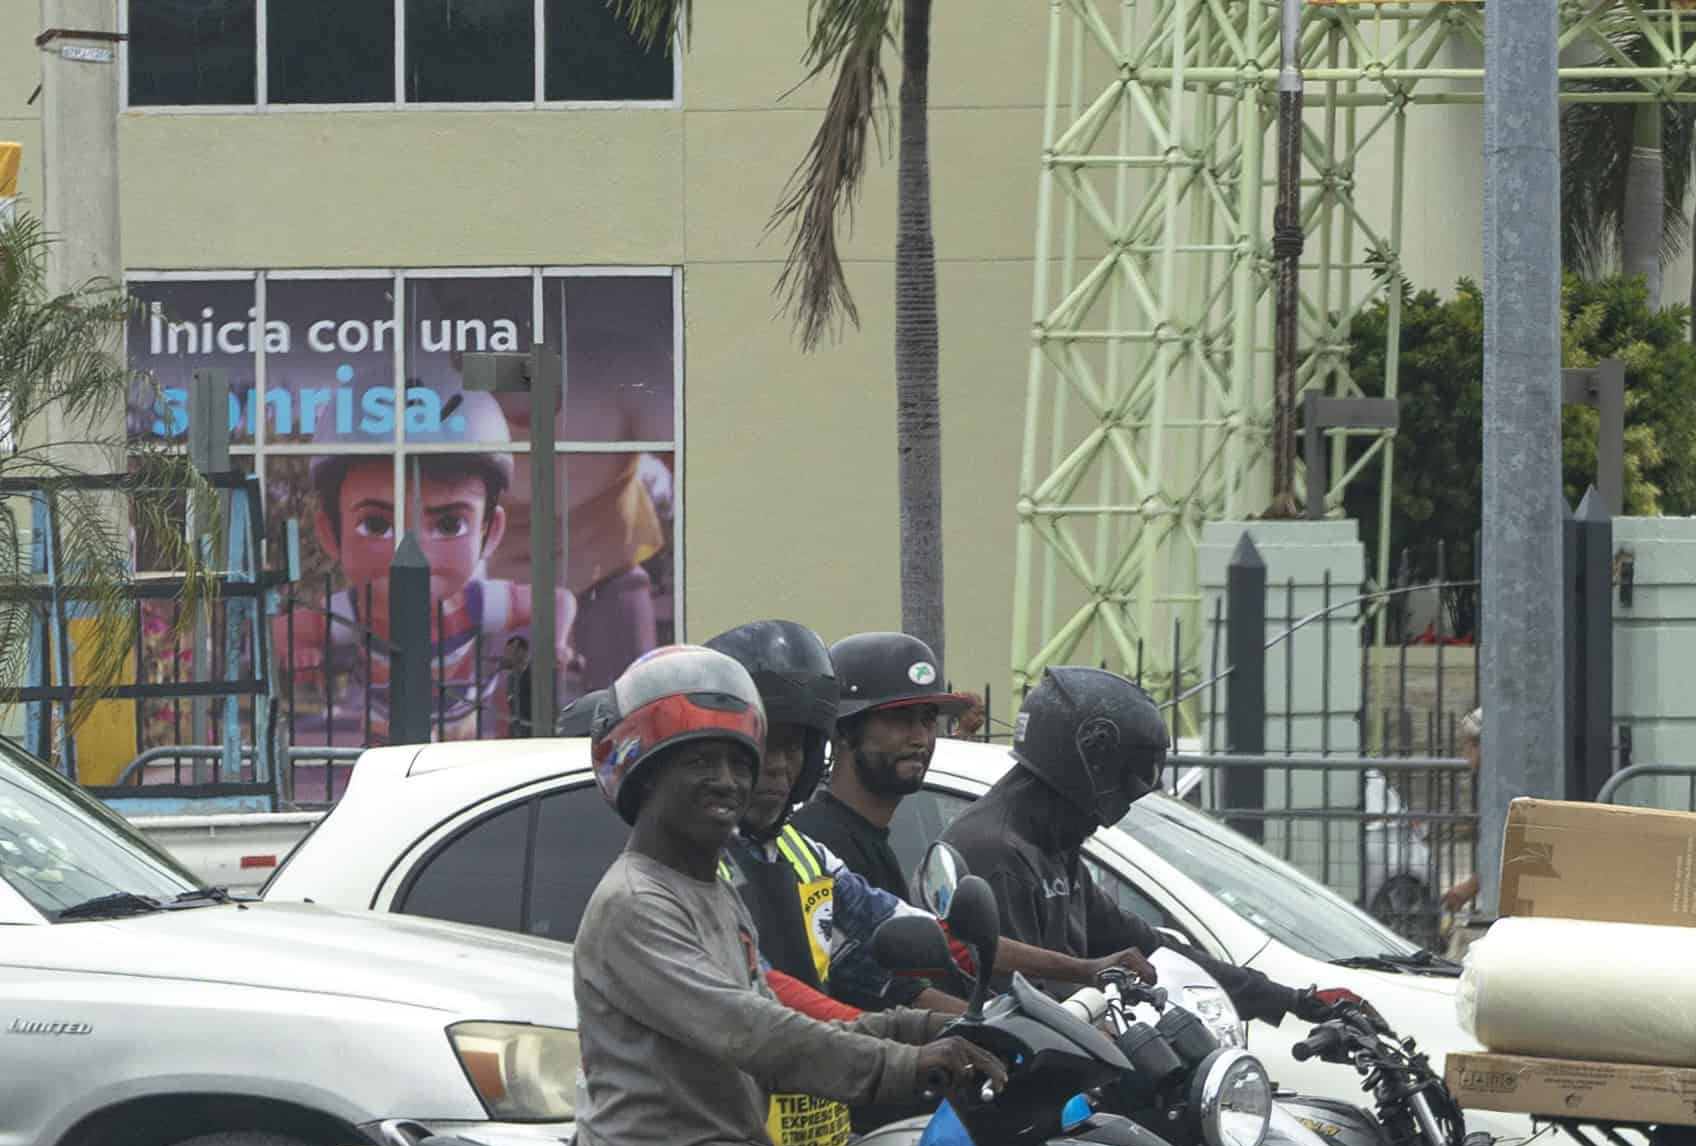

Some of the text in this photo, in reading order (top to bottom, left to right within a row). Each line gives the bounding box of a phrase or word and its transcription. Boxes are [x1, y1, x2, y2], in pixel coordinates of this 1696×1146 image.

[150, 300, 291, 354] Inicia
[420, 318, 519, 352] una
[151, 364, 466, 436] snrisa.
